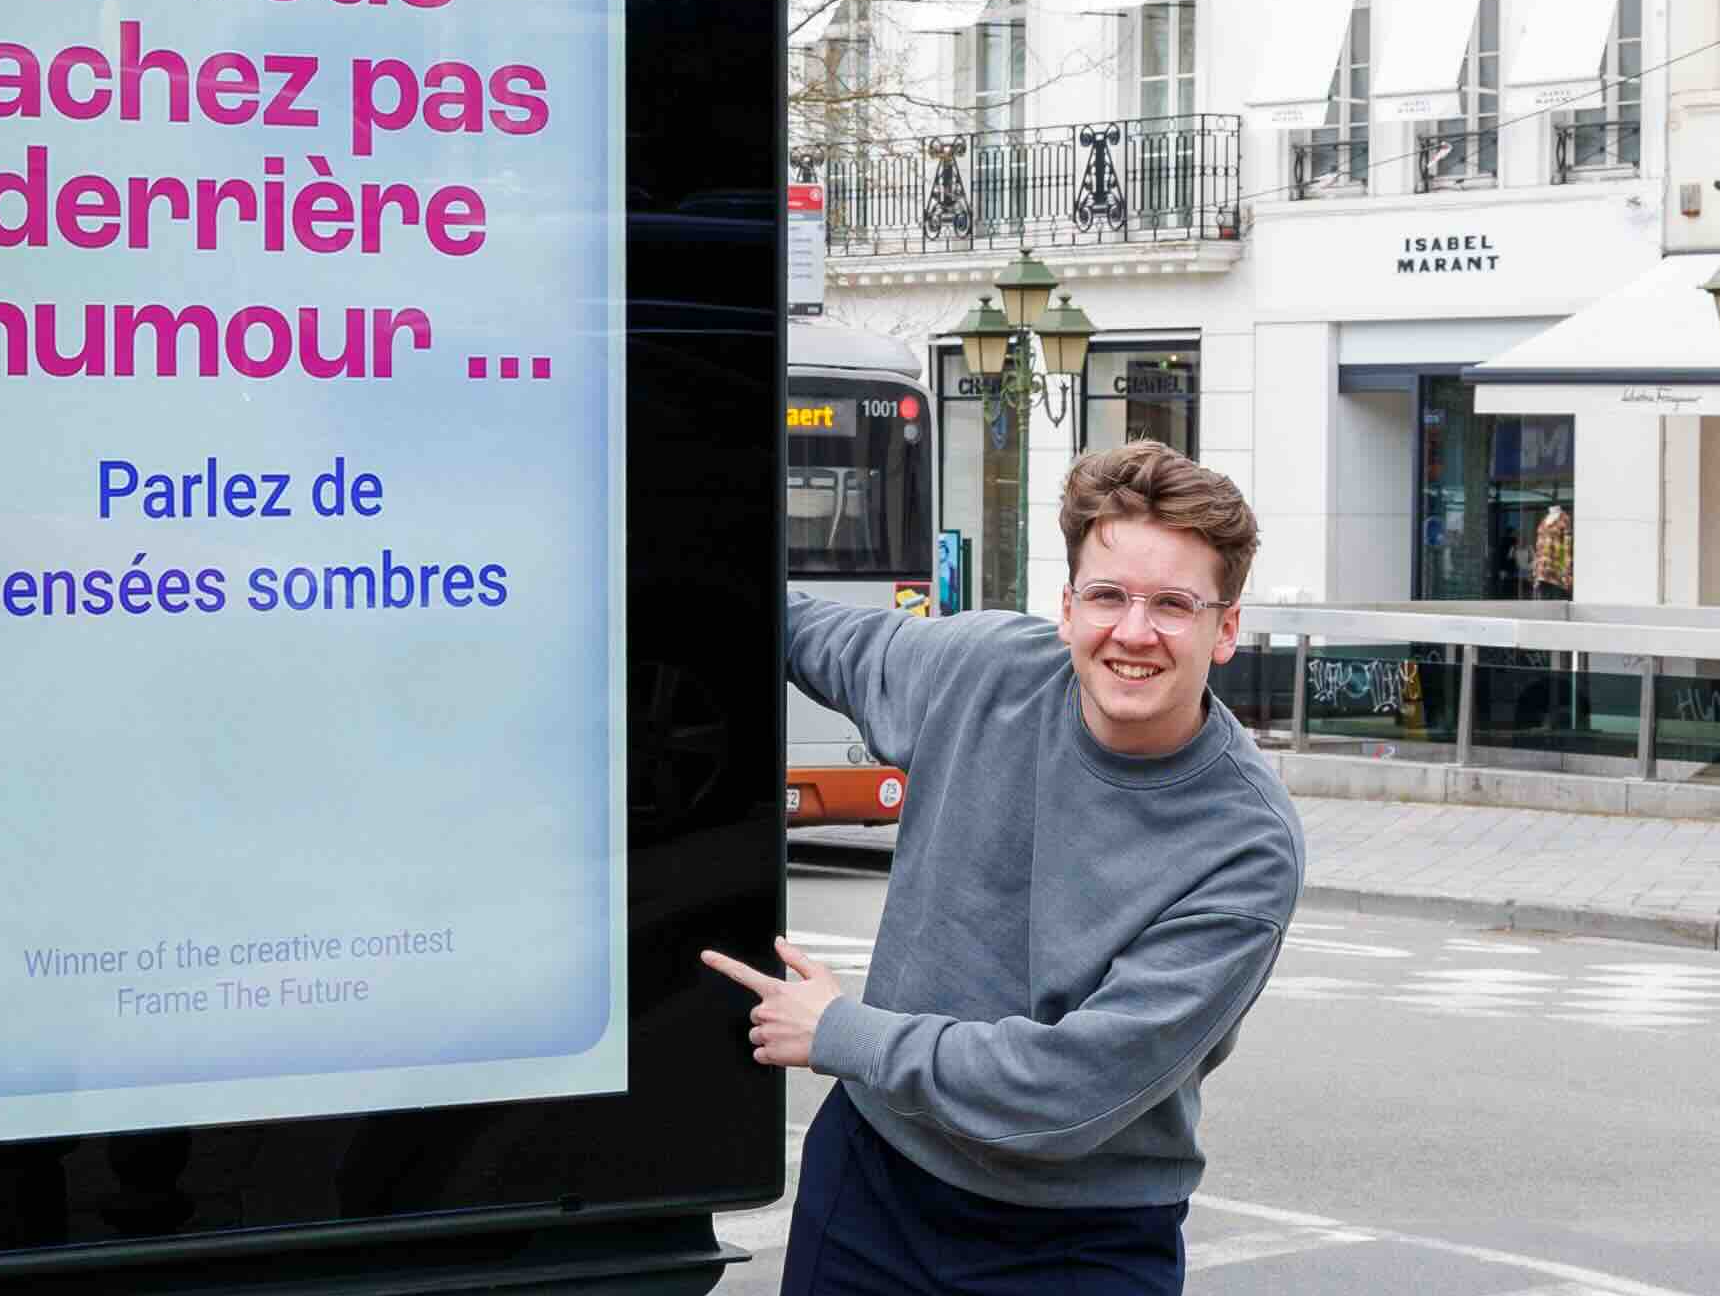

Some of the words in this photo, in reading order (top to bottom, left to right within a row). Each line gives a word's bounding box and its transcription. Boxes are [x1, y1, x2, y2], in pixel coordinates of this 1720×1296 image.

[352, 58, 549, 157] pas
[1397, 254, 1500, 273] MARANT
[1405, 235, 1494, 253] ISABEL
[786, 405, 835, 427] aert
[862, 399, 899, 418] 1001
[99, 456, 292, 520] Parlez
[311, 456, 383, 518] de
[247, 548, 508, 611] sombres
[23, 946, 128, 979] Winner
[136, 939, 169, 972] of
[176, 937, 221, 970] the
[228, 932, 343, 967] creative
[350, 926, 457, 959] contest
[117, 985, 209, 1018] Frame
[216, 980, 272, 1010] The
[279, 975, 371, 1007] Future
